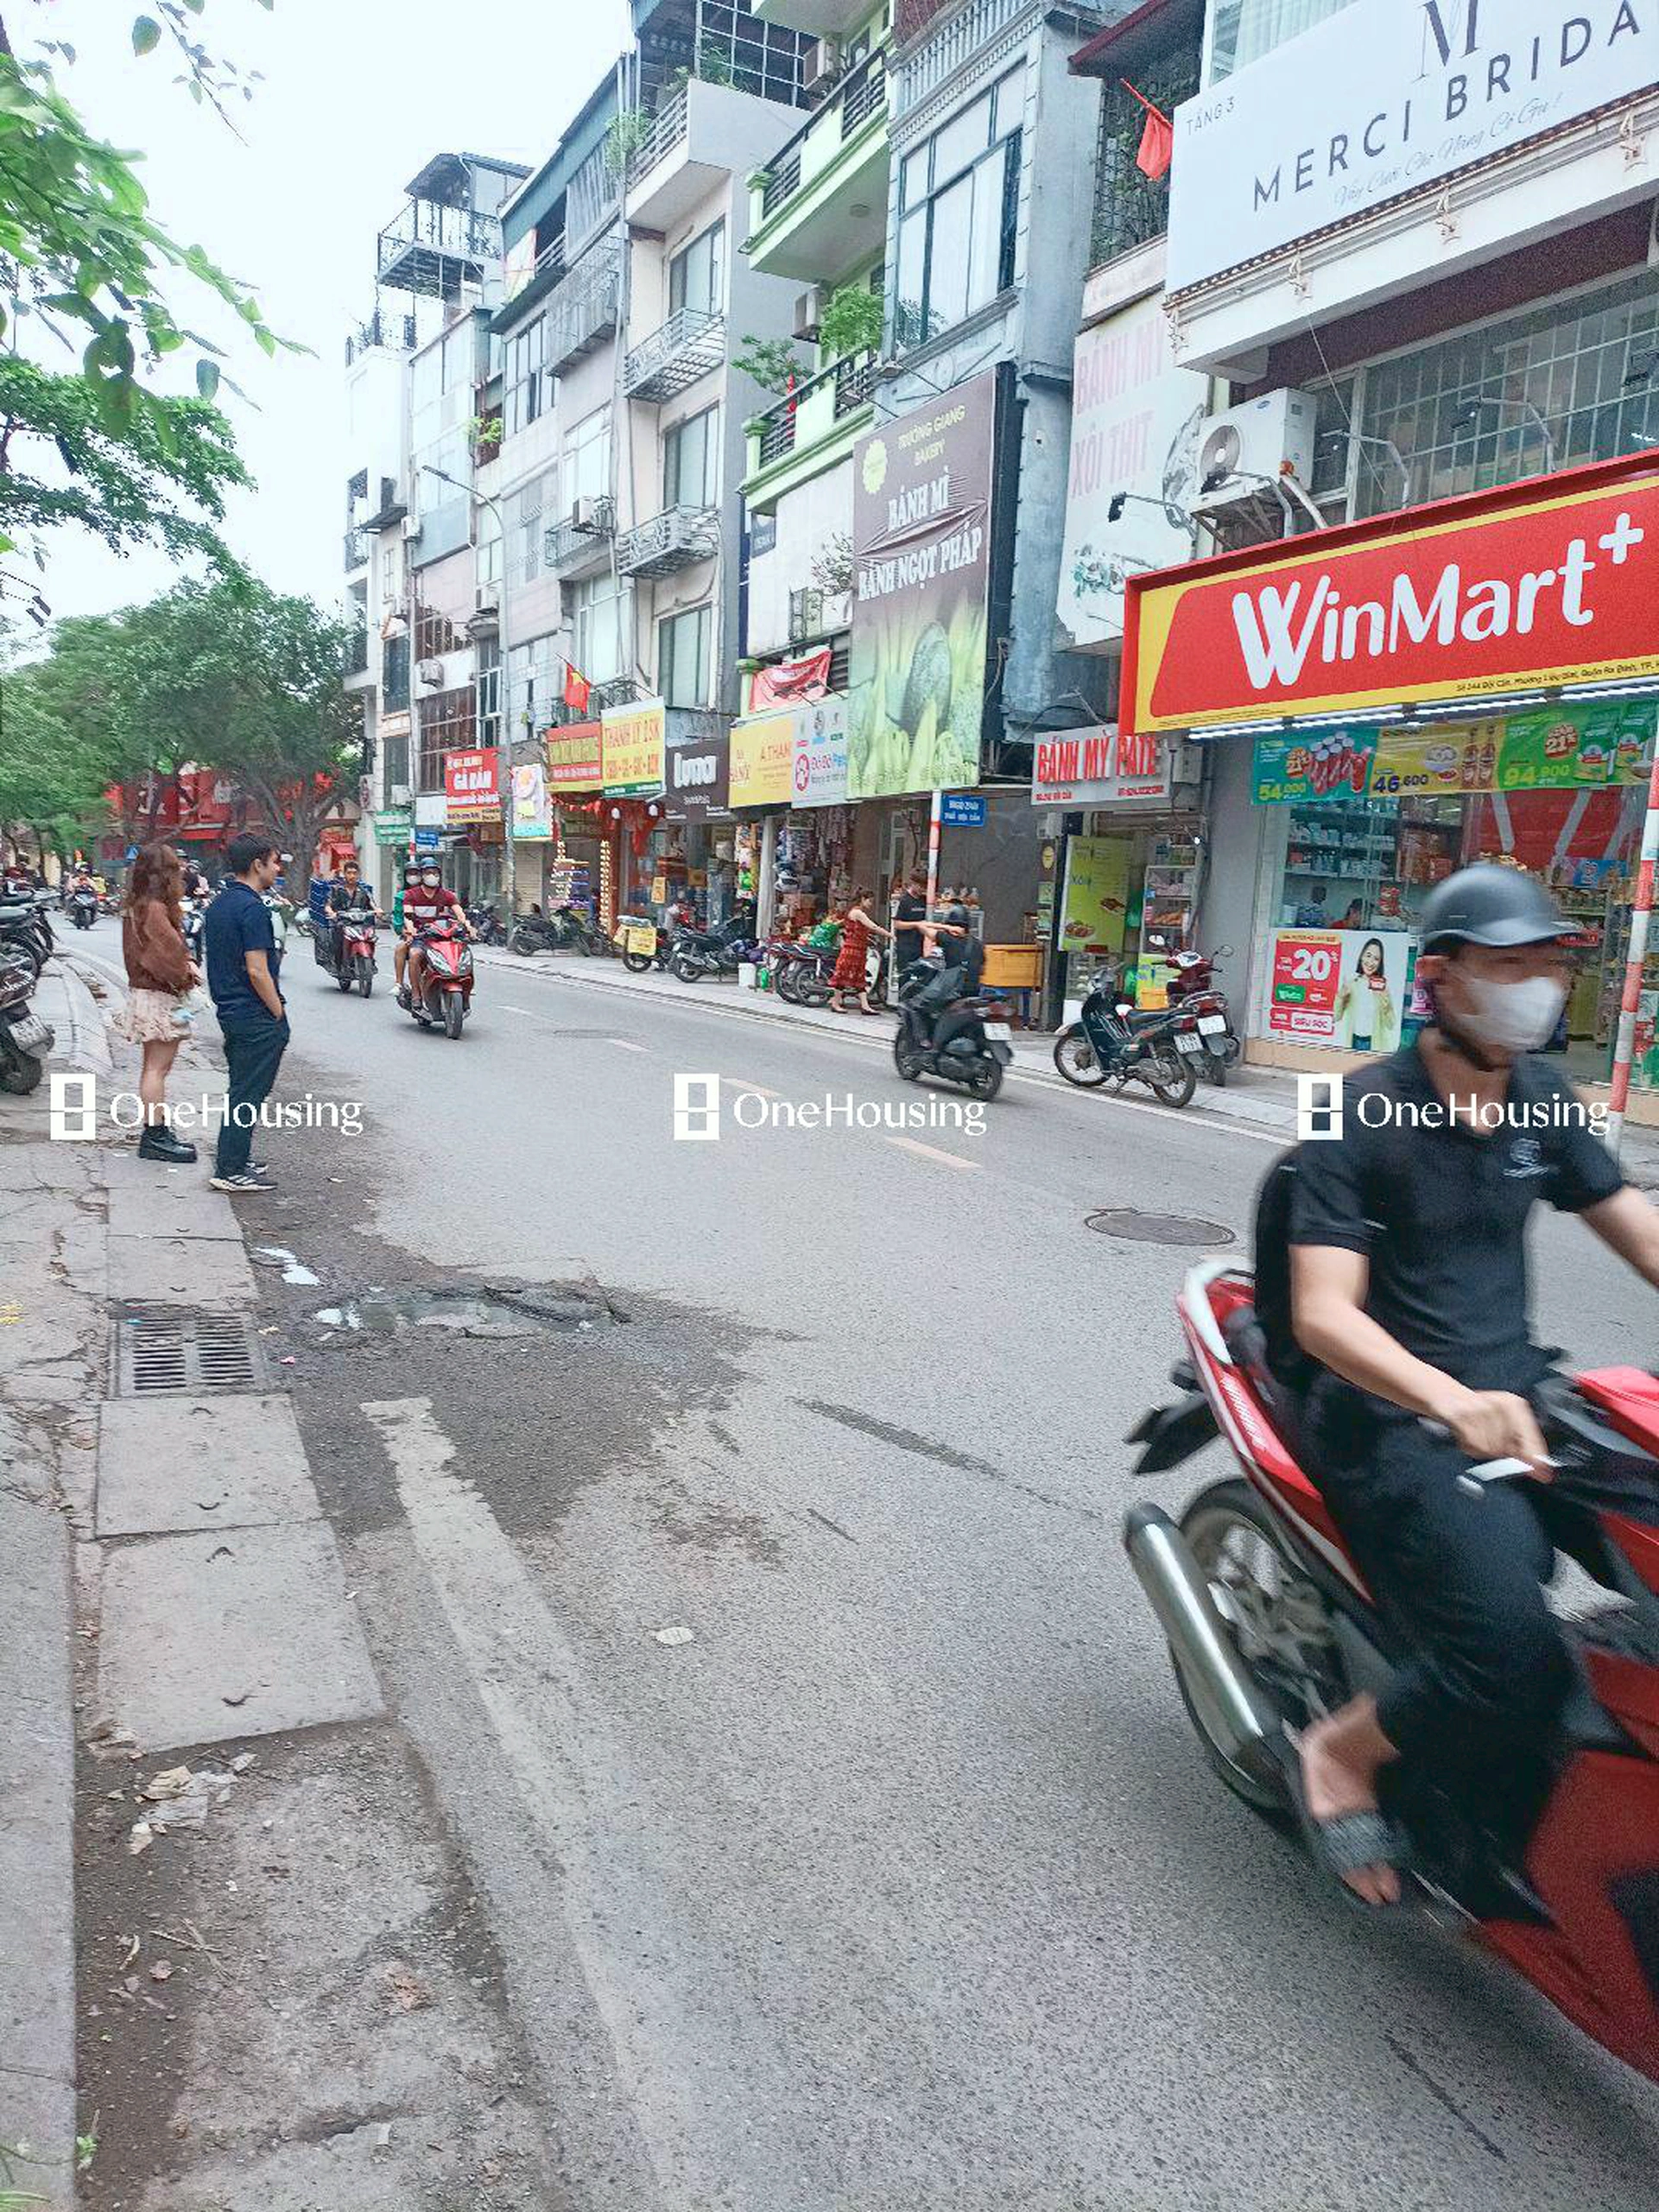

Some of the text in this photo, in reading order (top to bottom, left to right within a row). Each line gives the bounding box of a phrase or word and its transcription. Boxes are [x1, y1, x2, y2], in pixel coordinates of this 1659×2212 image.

[1254, 99, 1412, 212] MERCI
[888, 485, 928, 531] BÁNH
[898, 545, 937, 589] NGỌT
[939, 521, 983, 574] PHÁP
